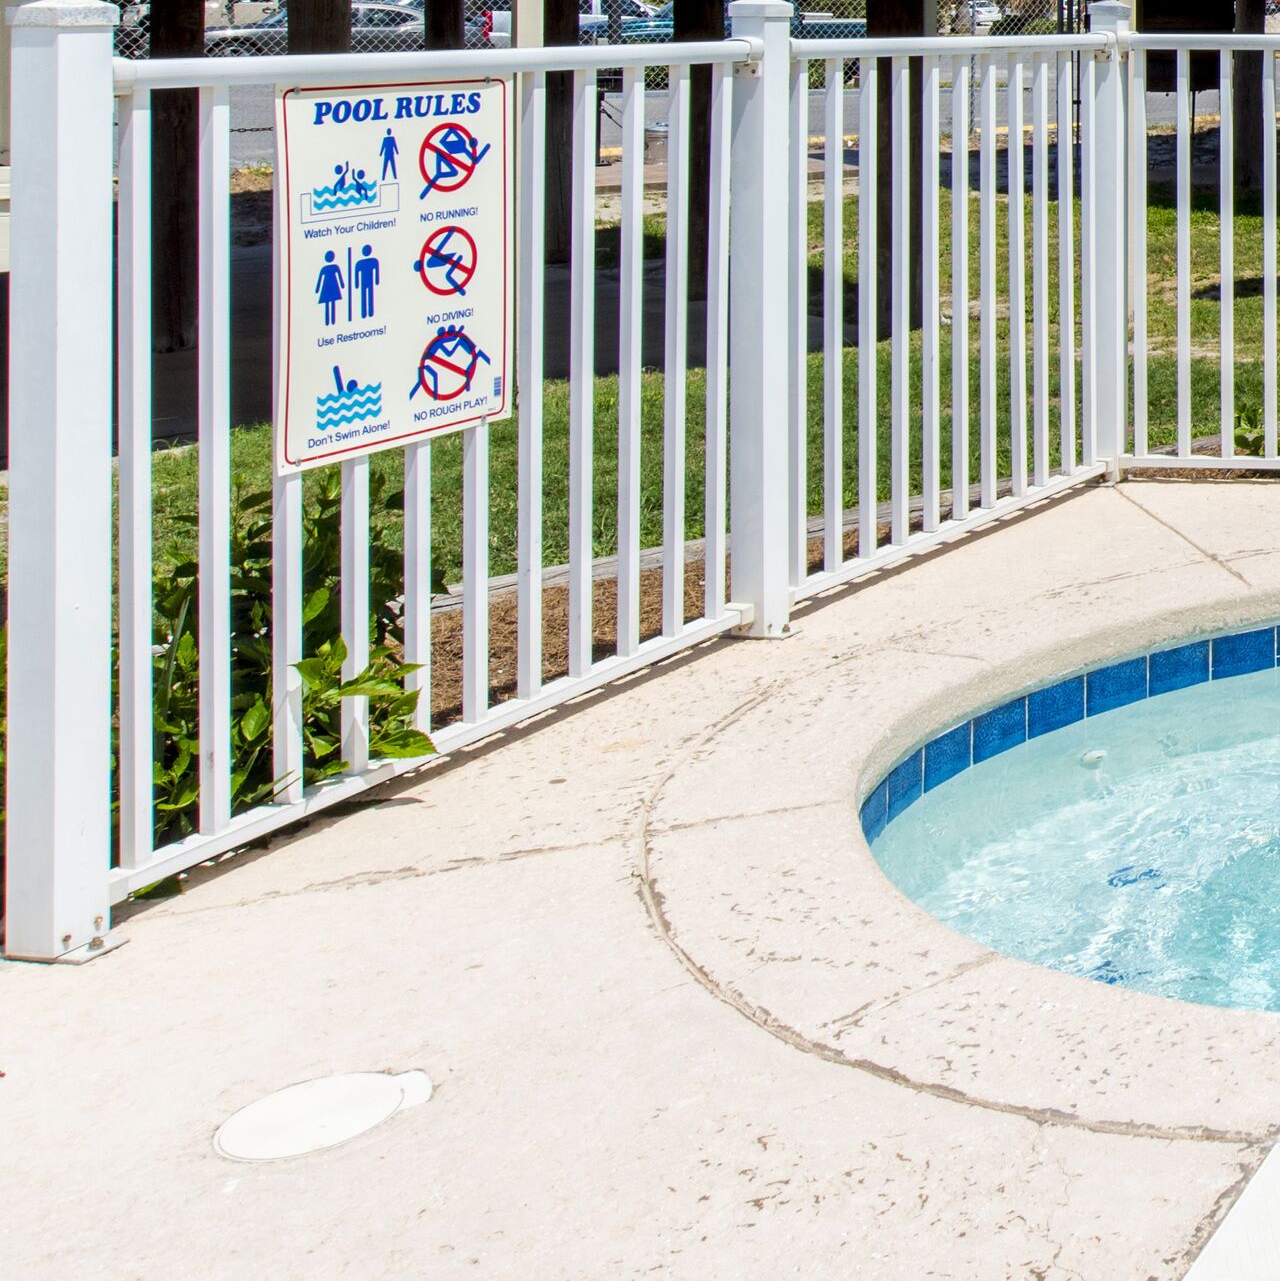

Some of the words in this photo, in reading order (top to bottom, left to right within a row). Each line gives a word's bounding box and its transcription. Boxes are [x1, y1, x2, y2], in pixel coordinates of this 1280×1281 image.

[313, 99, 388, 125] POOL
[394, 92, 481, 119] RULES
[420, 213, 434, 222] NO
[435, 207, 478, 220] RUNNING!
[304, 228, 333, 239] Watch
[334, 225, 354, 235] Your
[356, 219, 396, 232] Children!
[427, 315, 441, 325] NO
[442, 308, 474, 322] DIVING!
[317, 337, 335, 347] Use
[336, 326, 386, 344] Restrooms!
[414, 411, 427, 422] NO
[429, 404, 462, 418] ROUGH
[463, 396, 488, 411] PLAY!
[308, 435, 333, 449] Don't
[335, 429, 360, 442] Swim
[362, 420, 391, 435] Alone!
